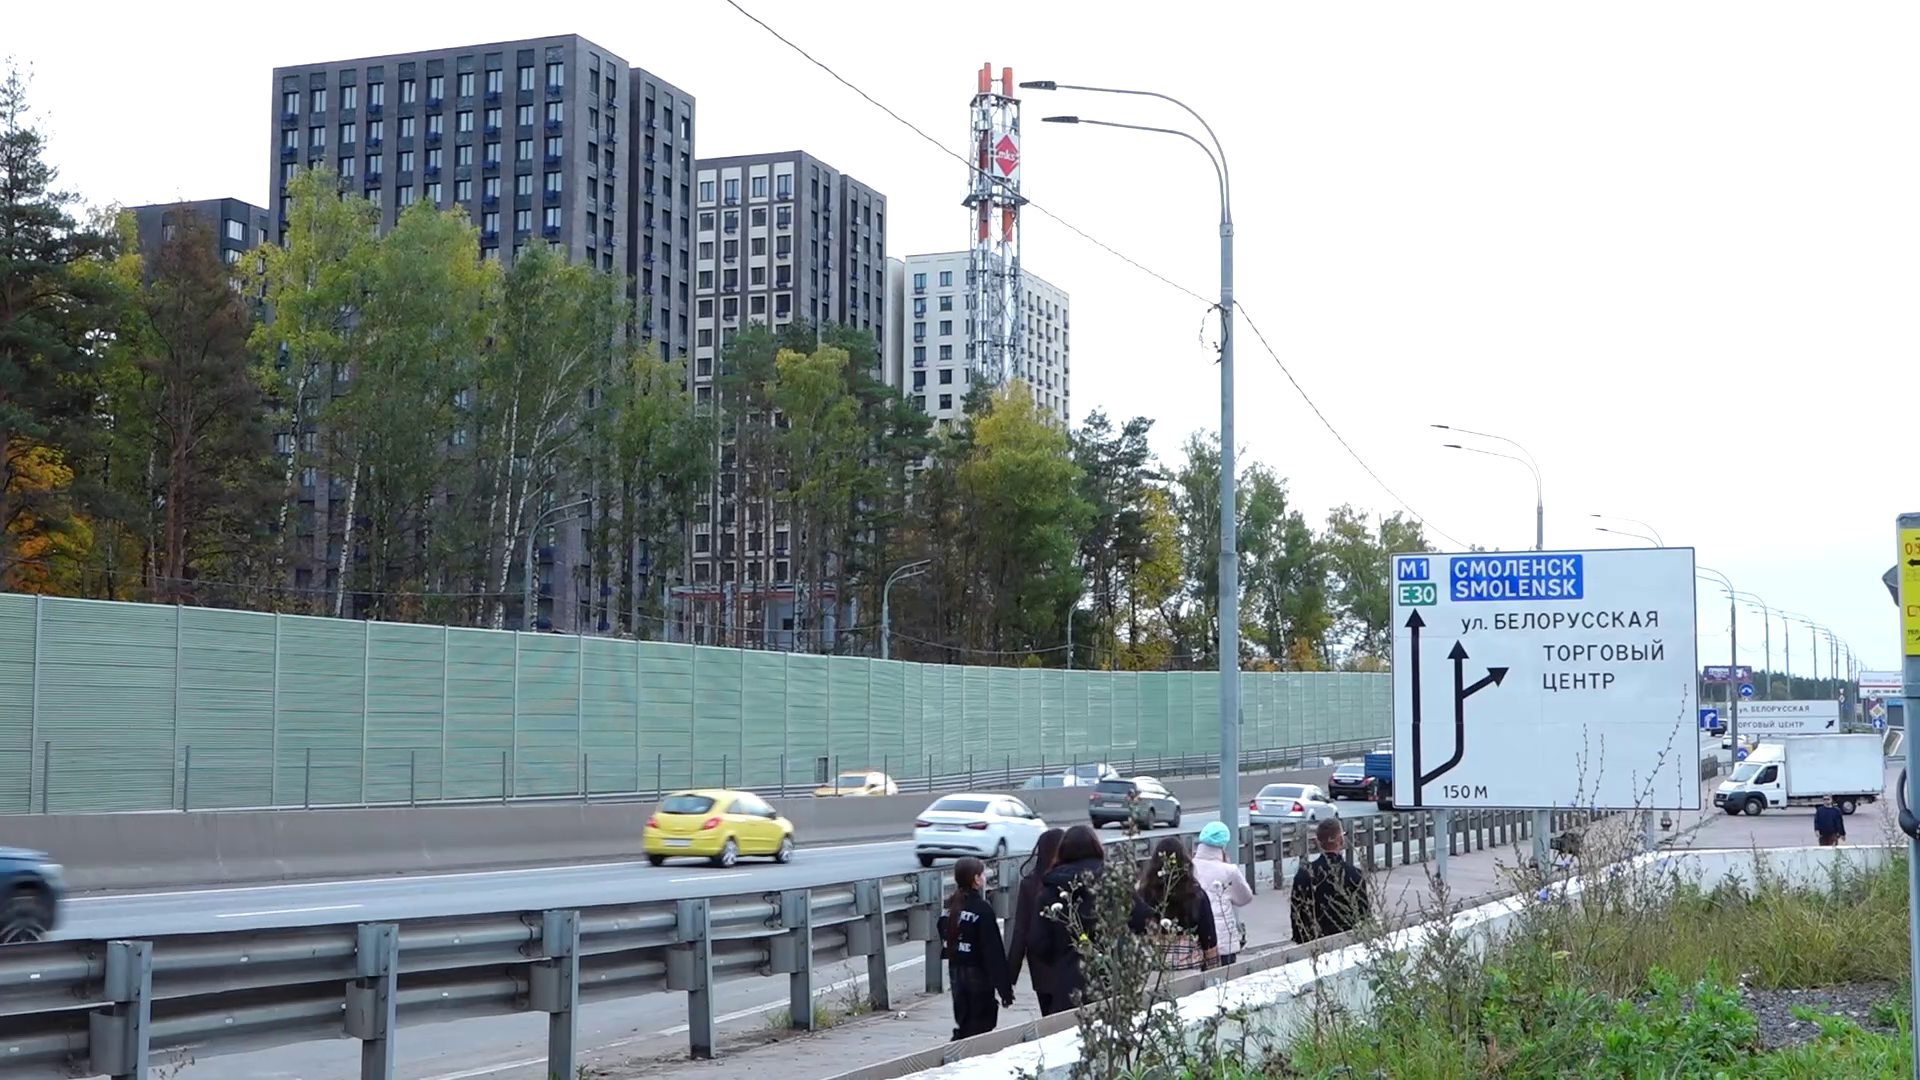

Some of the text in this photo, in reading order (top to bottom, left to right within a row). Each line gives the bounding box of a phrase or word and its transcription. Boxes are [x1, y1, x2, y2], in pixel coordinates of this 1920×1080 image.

[1400, 561, 1428, 578] М1
[1454, 558, 1577, 578] СМОЛЕНСК
[1399, 586, 1435, 603] E30
[1455, 578, 1577, 598] SMOLENSK
[1461, 611, 1659, 634] ул. БЕЛОРУССКАЯ
[1543, 639, 1664, 661] ТОРГОВЫЙ
[1543, 673, 1615, 692] ЦЕНТР
[1751, 705, 1810, 713] БЕЛОРУССКАЯ
[1736, 720, 1804, 729] ОРГОВЫЙ ЦЕНТР
[1443, 785, 1470, 799] 150
